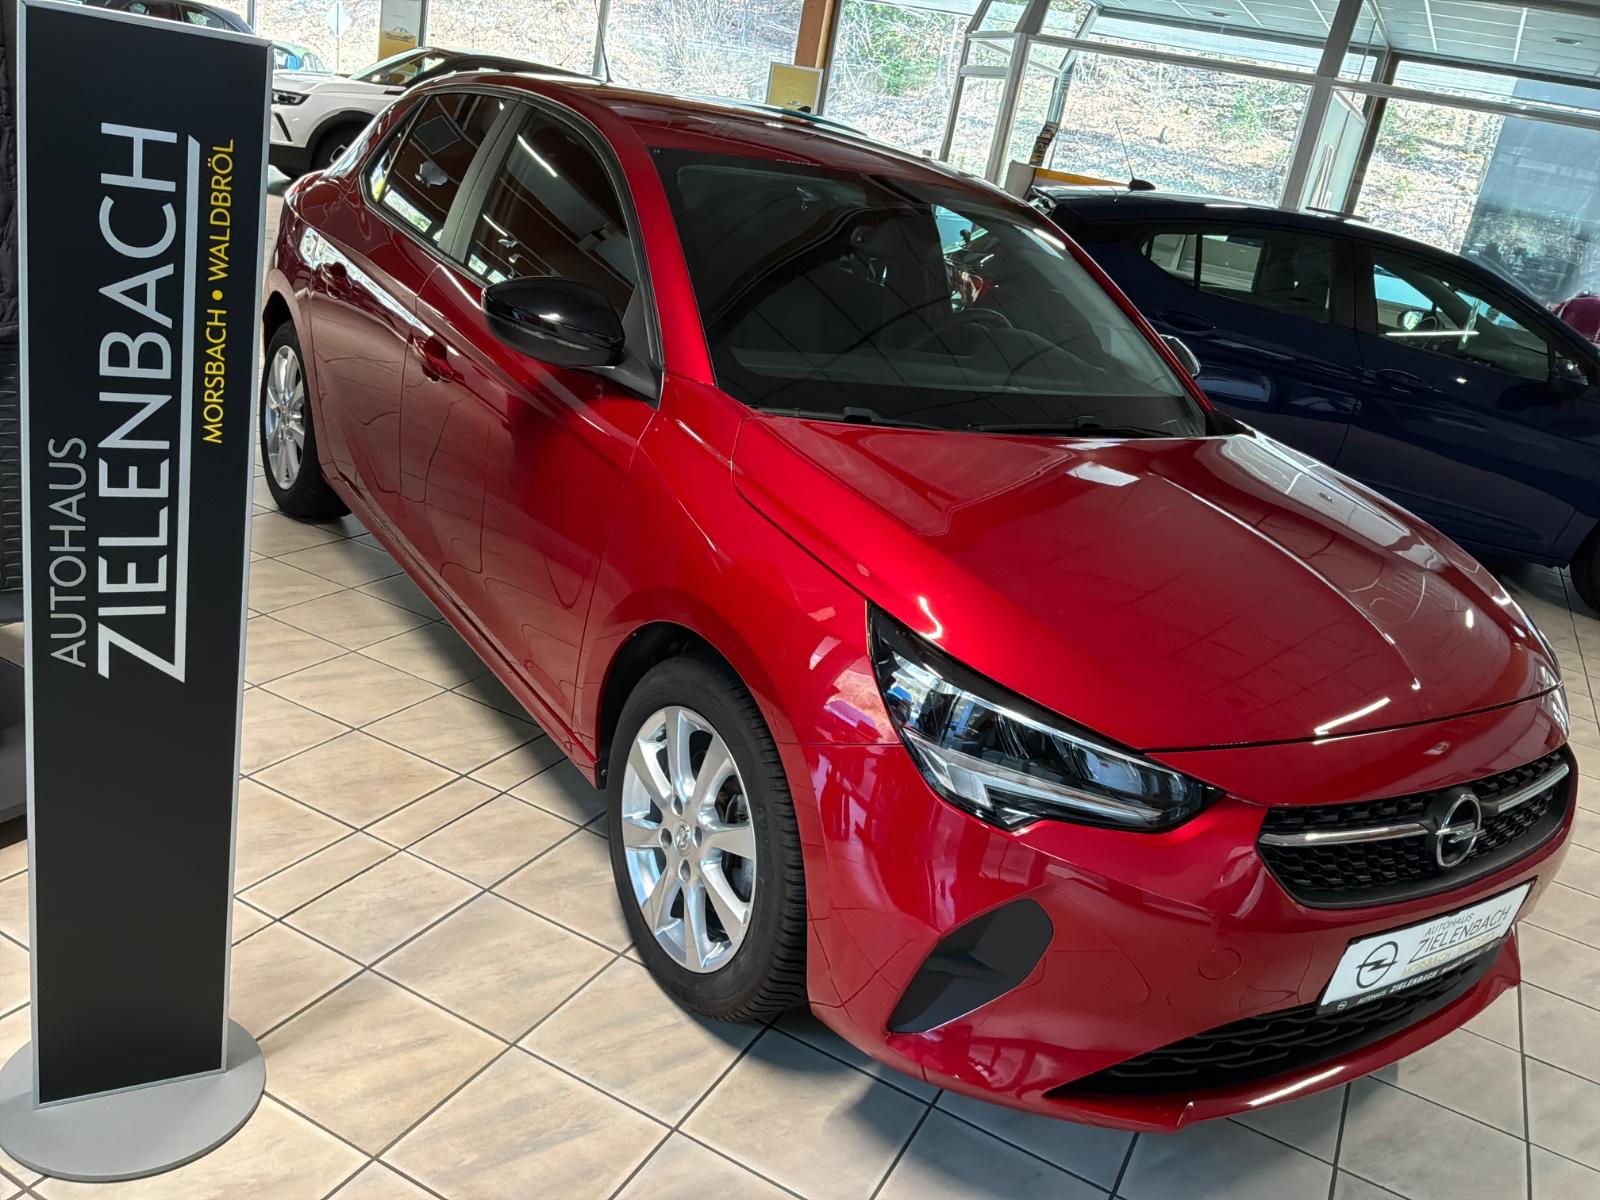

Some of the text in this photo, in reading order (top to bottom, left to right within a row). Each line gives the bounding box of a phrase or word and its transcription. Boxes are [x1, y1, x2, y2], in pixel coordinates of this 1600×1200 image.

[98, 122, 188, 683] ZIELENBACH
[202, 139, 234, 444] MORSBACH WALDBRÖL
[48, 437, 87, 668] AUTOHAUS
[1407, 905, 1512, 963] ZIELENBACH
[1425, 912, 1474, 936] AUTOHAUS
